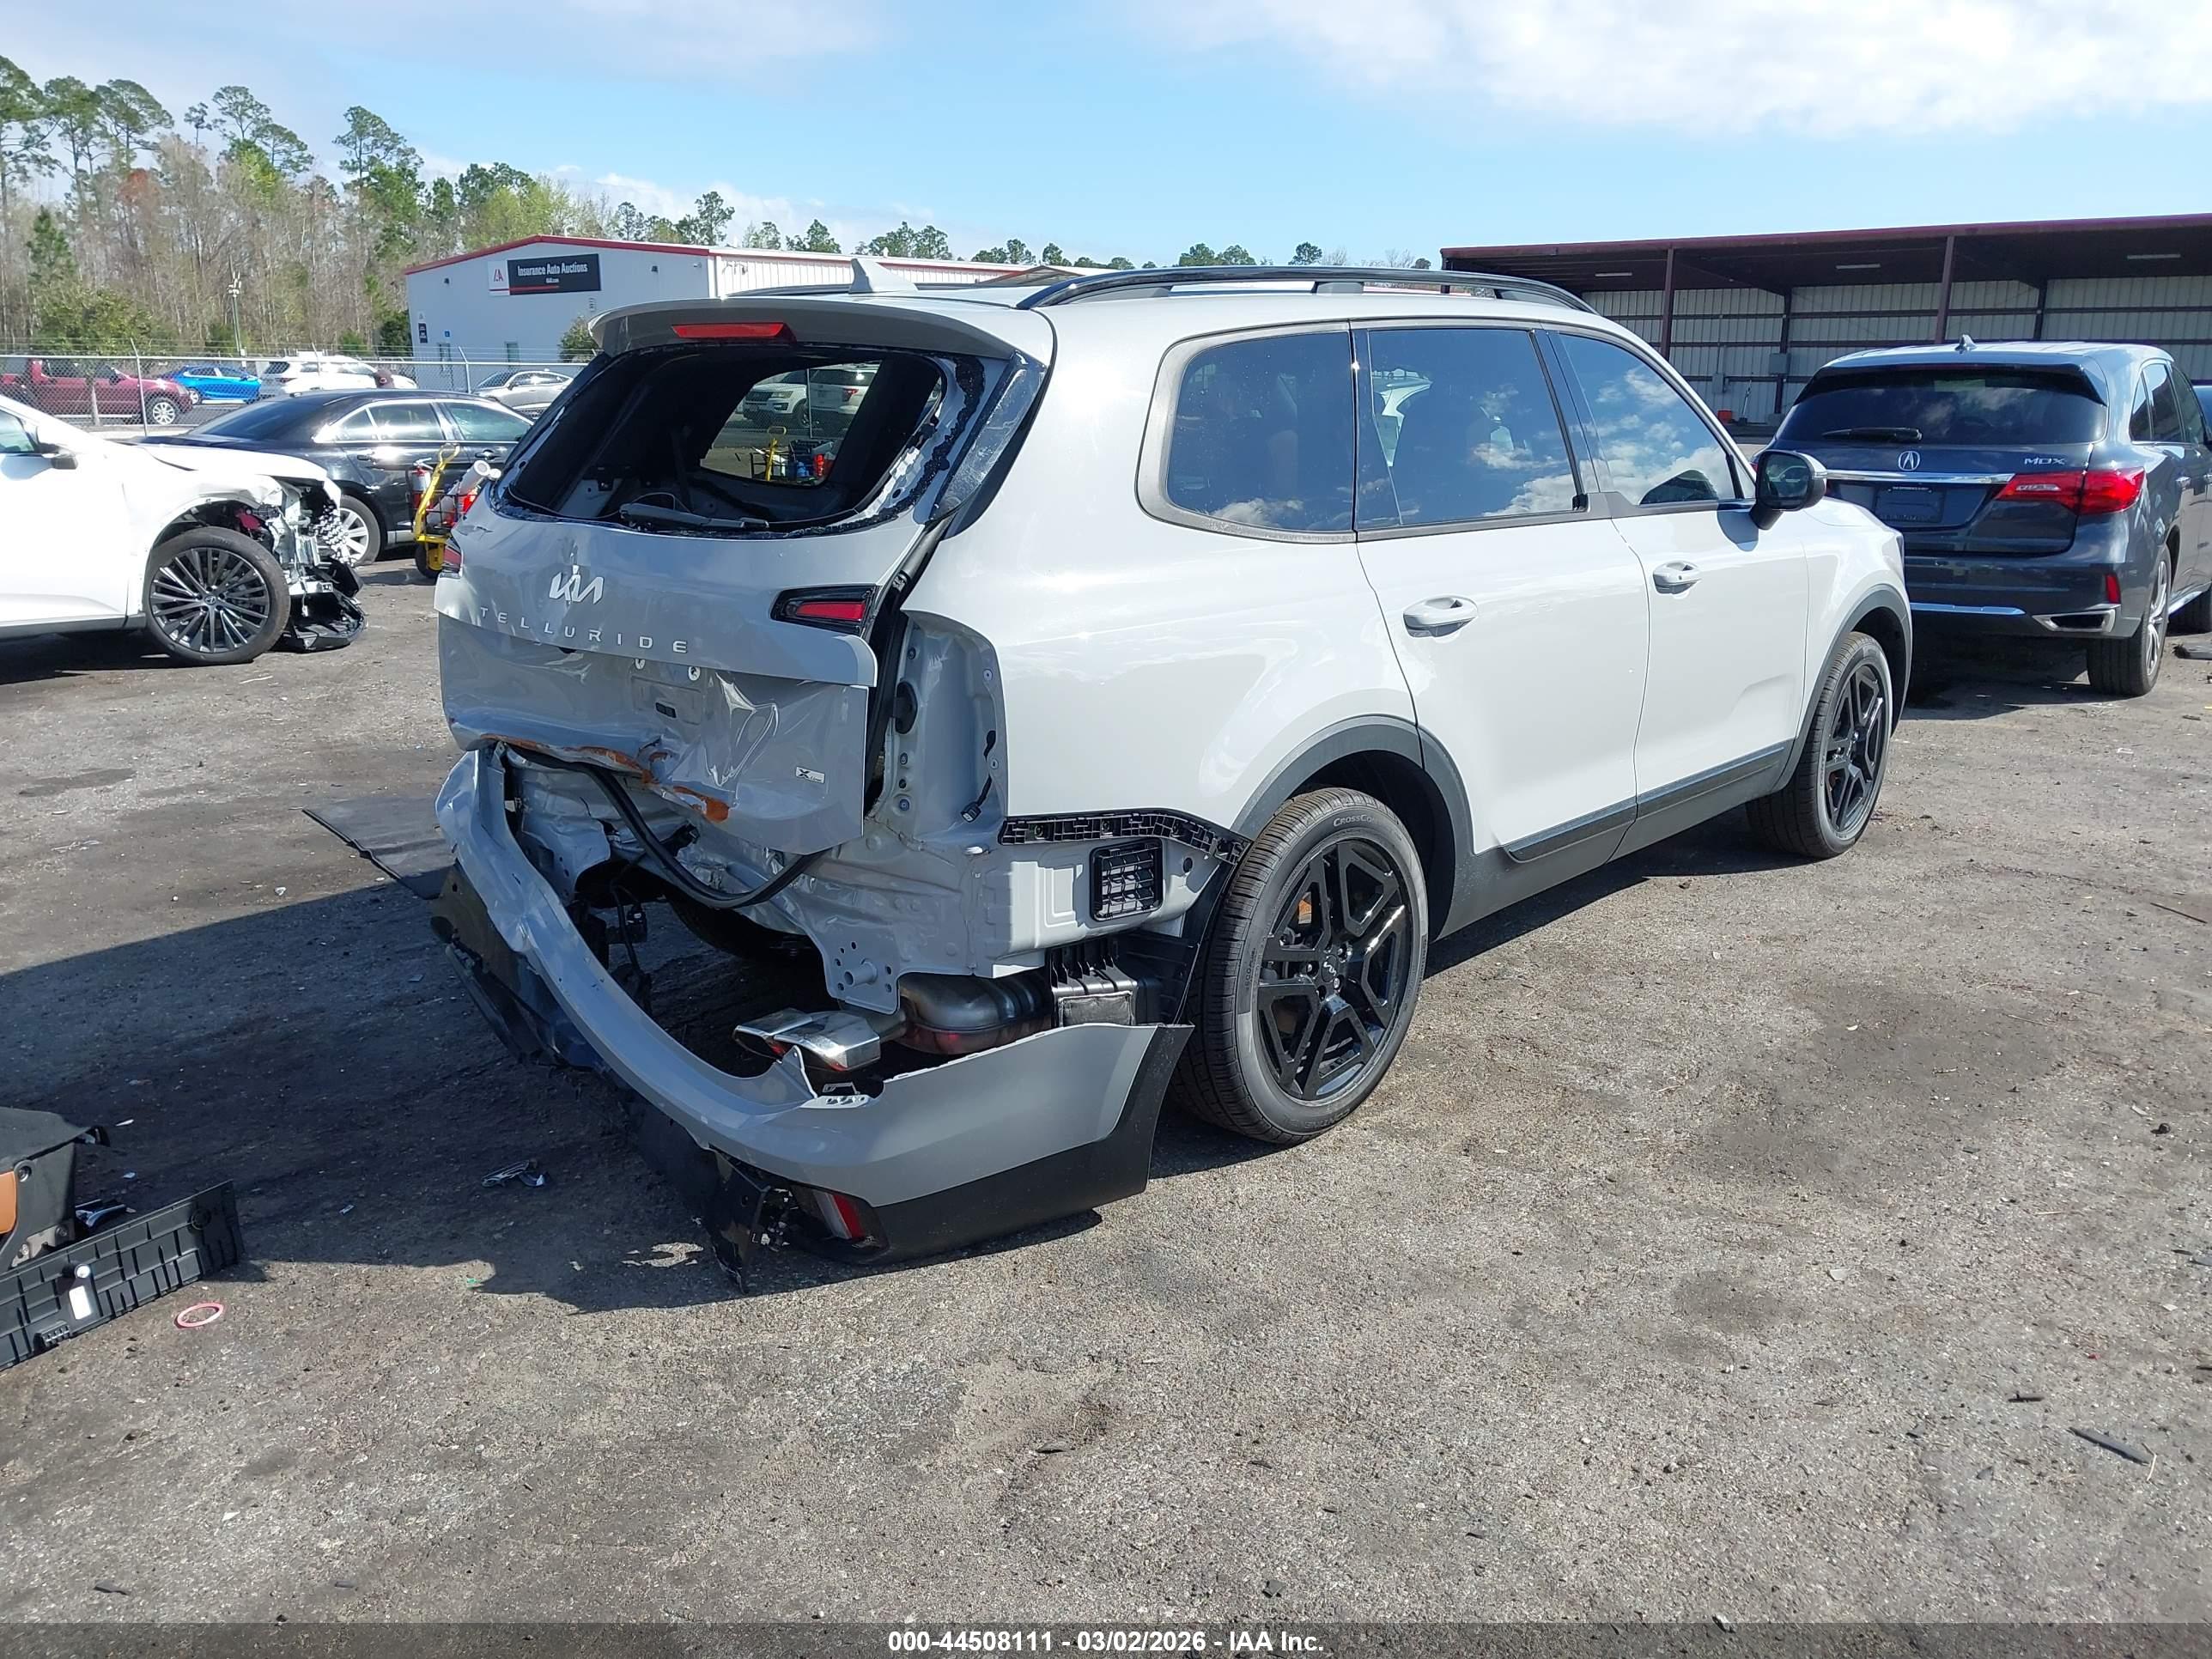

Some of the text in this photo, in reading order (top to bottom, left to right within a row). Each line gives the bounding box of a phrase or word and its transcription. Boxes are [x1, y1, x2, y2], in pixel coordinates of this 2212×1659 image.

[517, 261, 588, 277] Insurance Auto Auctions
[480, 607, 688, 653] TELLURIDE
